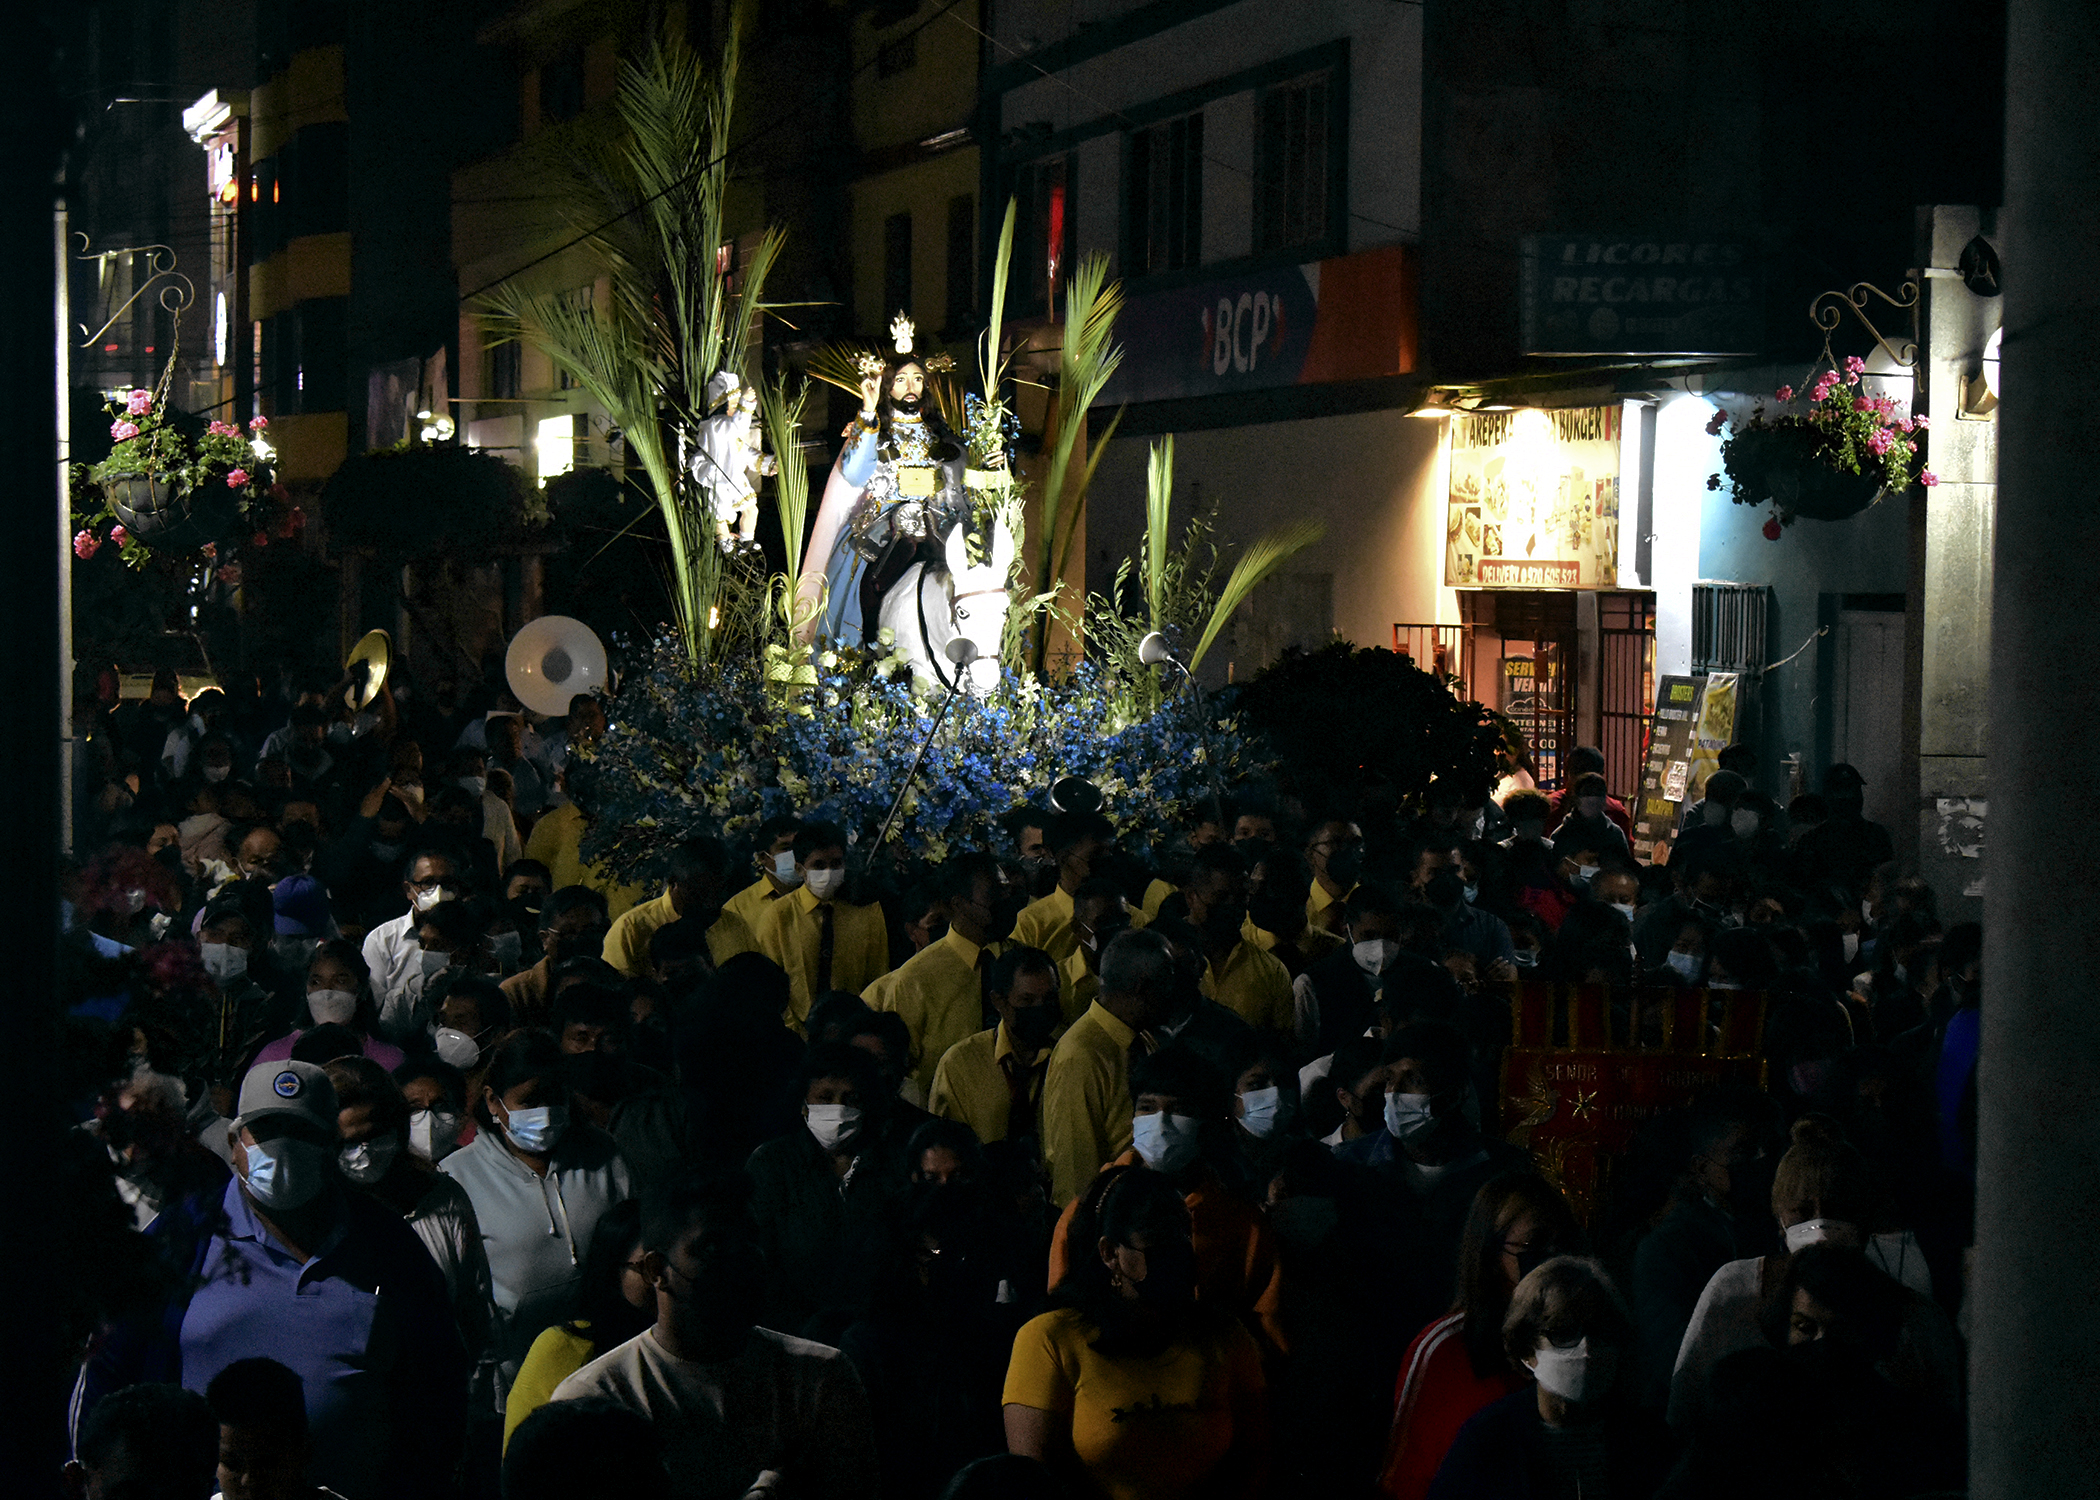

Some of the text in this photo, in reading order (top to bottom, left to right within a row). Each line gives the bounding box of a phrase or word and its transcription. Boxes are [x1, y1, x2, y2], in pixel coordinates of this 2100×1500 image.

[1561, 242, 1743, 266] LICORES
[1552, 276, 1752, 302] RECARGAS
[1213, 290, 1271, 376] BCP
[1559, 407, 1602, 443] BURGER
[1482, 565, 1520, 583] DELIVERY
